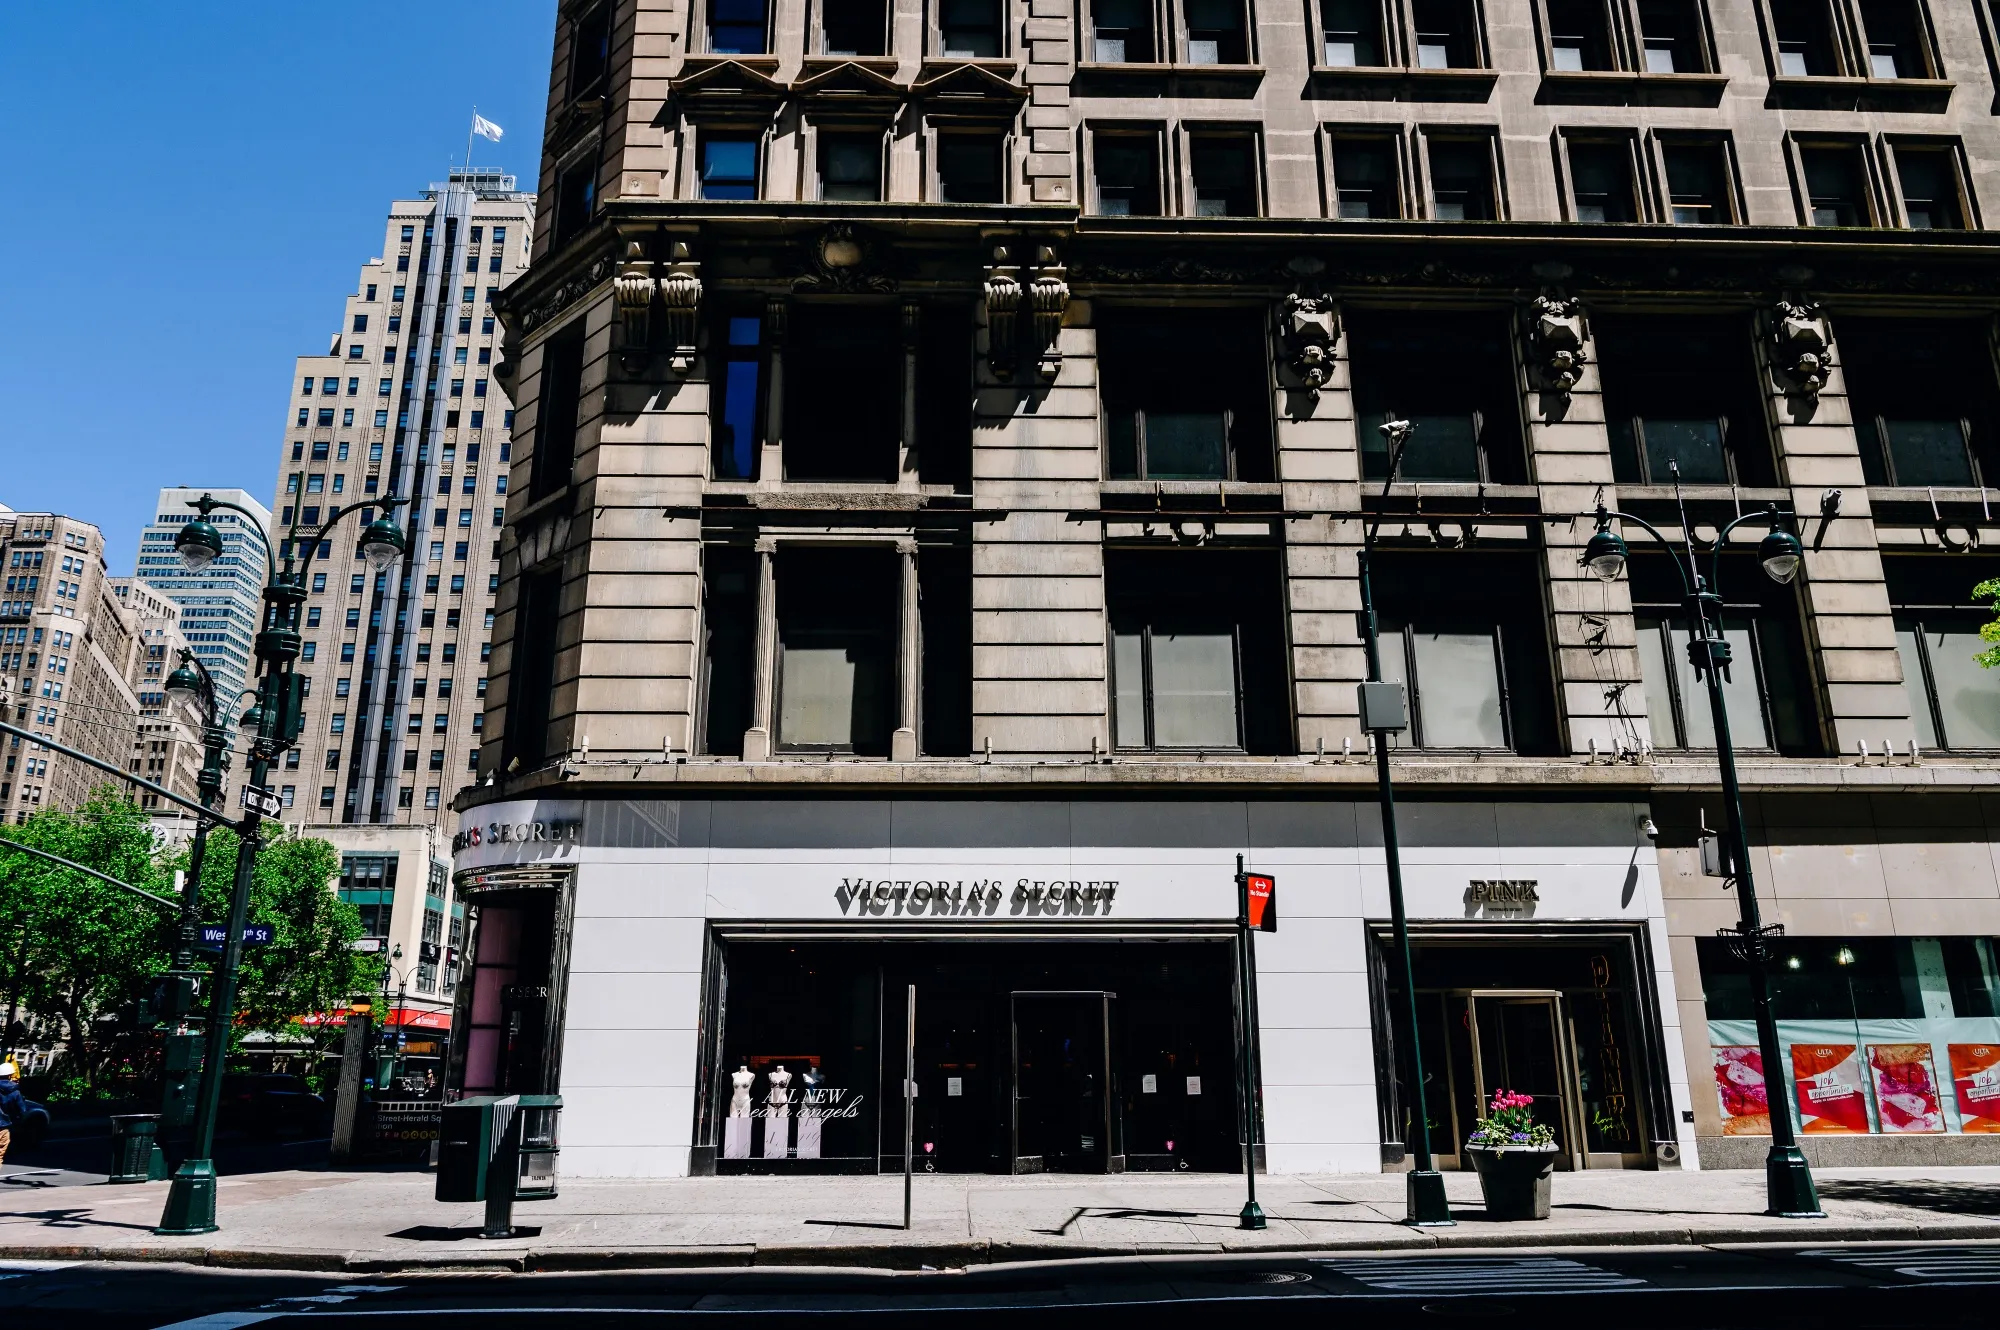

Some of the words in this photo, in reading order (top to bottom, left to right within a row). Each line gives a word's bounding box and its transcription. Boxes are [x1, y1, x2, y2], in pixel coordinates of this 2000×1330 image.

[487, 819, 582, 845] SECRET
[842, 877, 1003, 901] VICTORIA'S
[1017, 877, 1119, 901] SECRET
[1469, 879, 1540, 902] PINK
[205, 929, 226, 941] Wes
[256, 929, 267, 941] St
[1815, 1048, 1833, 1057] ULTA
[1972, 1048, 1990, 1057] ULTA
[762, 1088, 798, 1104] ALL
[801, 1088, 848, 1104] NEW
[377, 1114, 429, 1122] Street-Herald
[796, 1095, 864, 1126] angels
